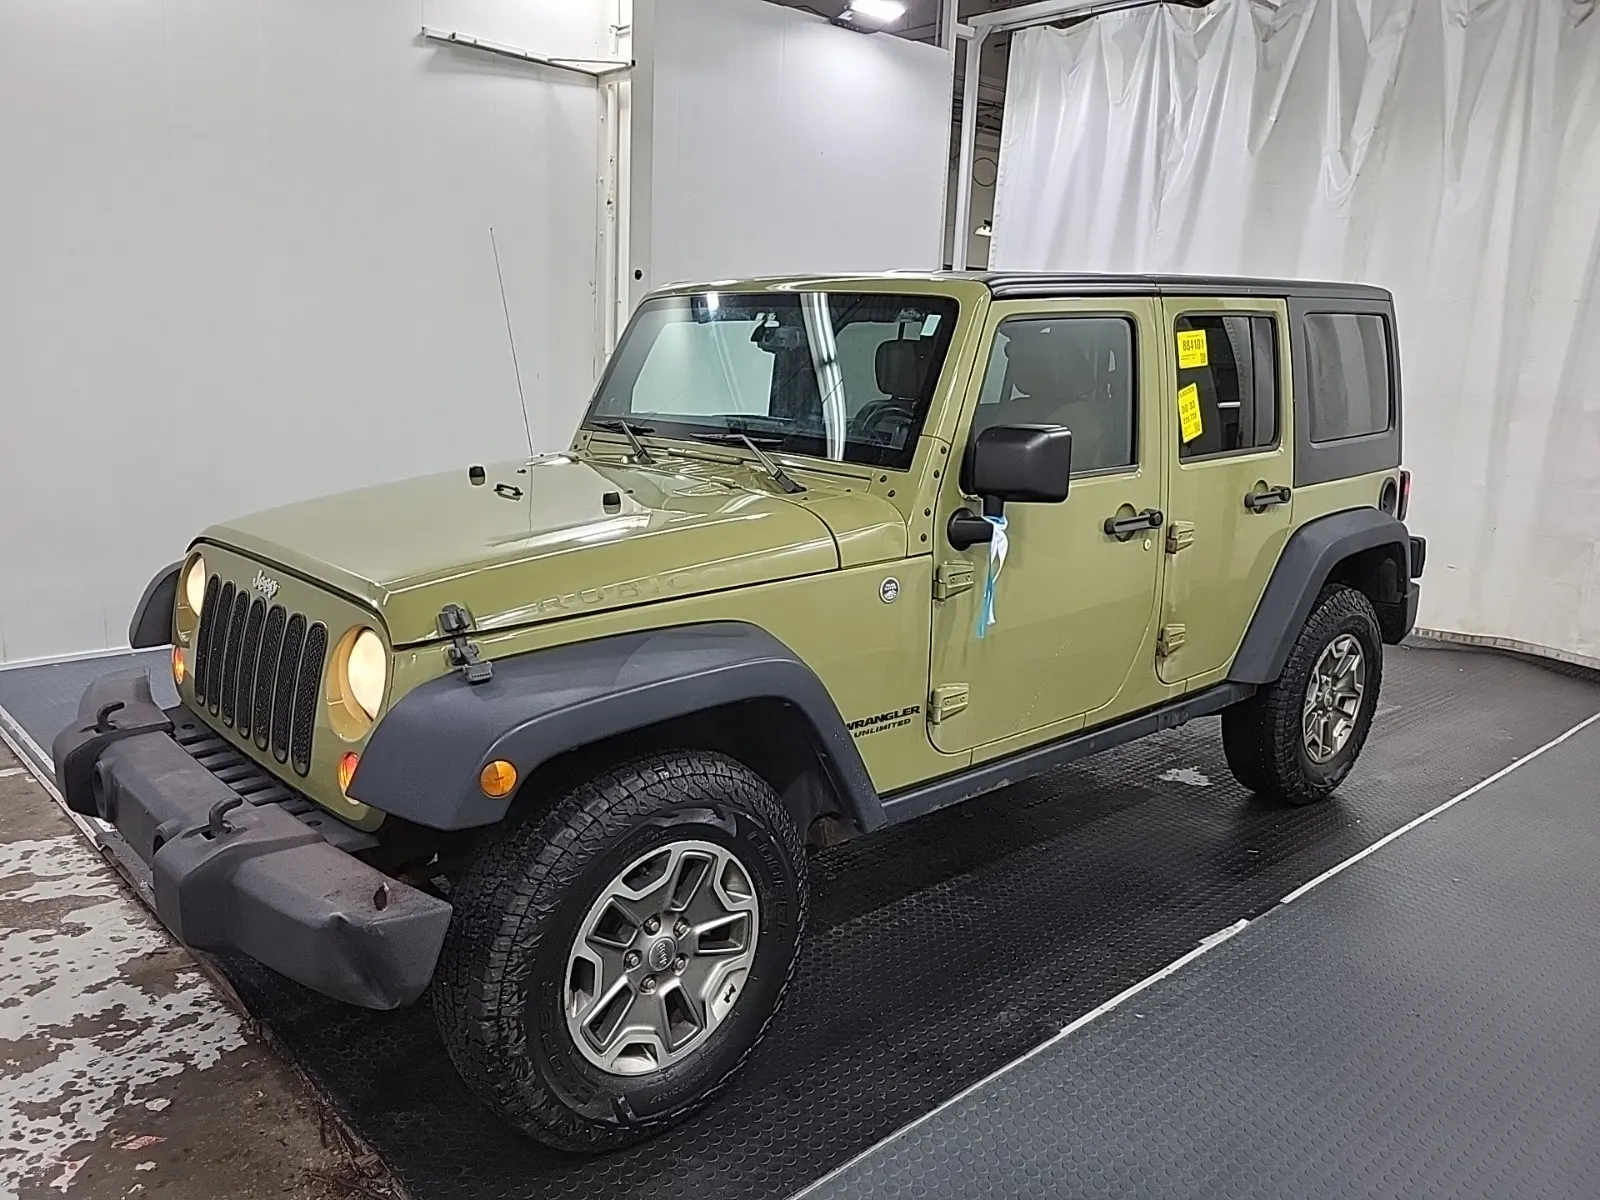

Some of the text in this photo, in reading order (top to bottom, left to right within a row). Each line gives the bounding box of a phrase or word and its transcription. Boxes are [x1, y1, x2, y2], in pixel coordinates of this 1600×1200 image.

[252, 569, 281, 599] Jeep
[846, 705, 921, 730] WRANGLER
[853, 718, 911, 738] UNLIMITED
